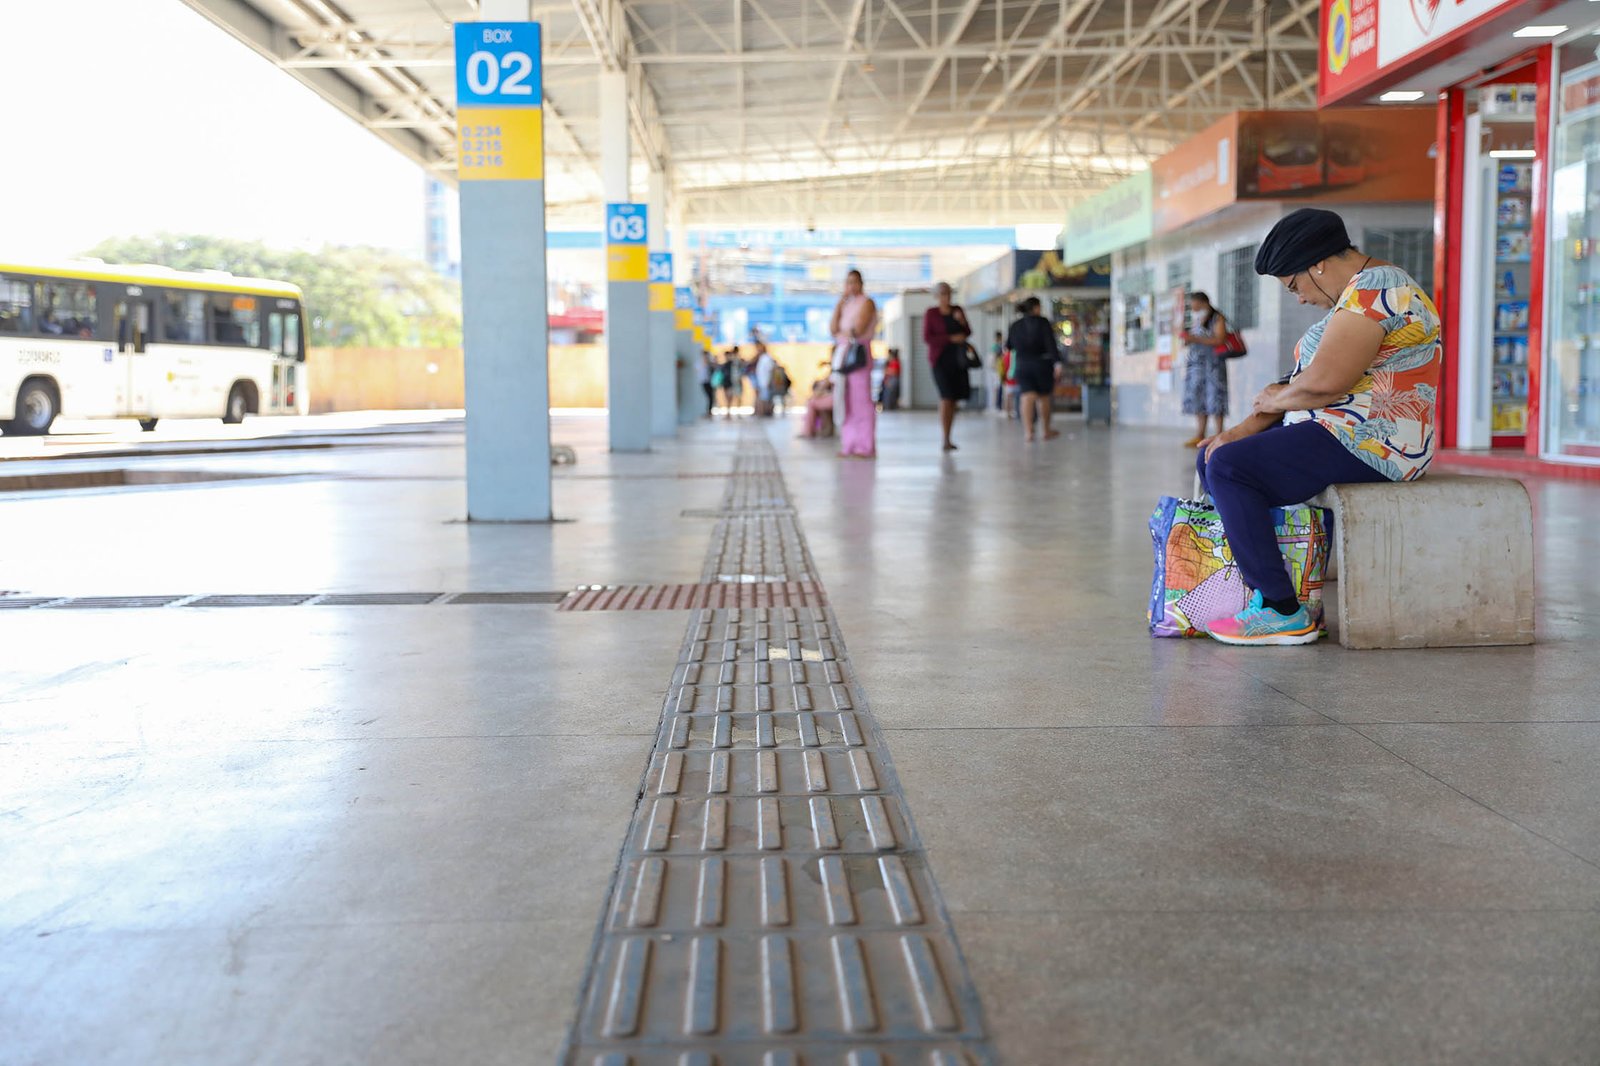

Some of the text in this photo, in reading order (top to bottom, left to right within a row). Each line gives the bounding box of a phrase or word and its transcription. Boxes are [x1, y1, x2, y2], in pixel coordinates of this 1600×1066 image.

[482, 28, 513, 43] BOX
[466, 51, 532, 95] 02
[461, 125, 502, 138] 0.234
[461, 140, 503, 152] 0.215
[462, 155, 504, 167] 0.216
[608, 216, 644, 240] 03
